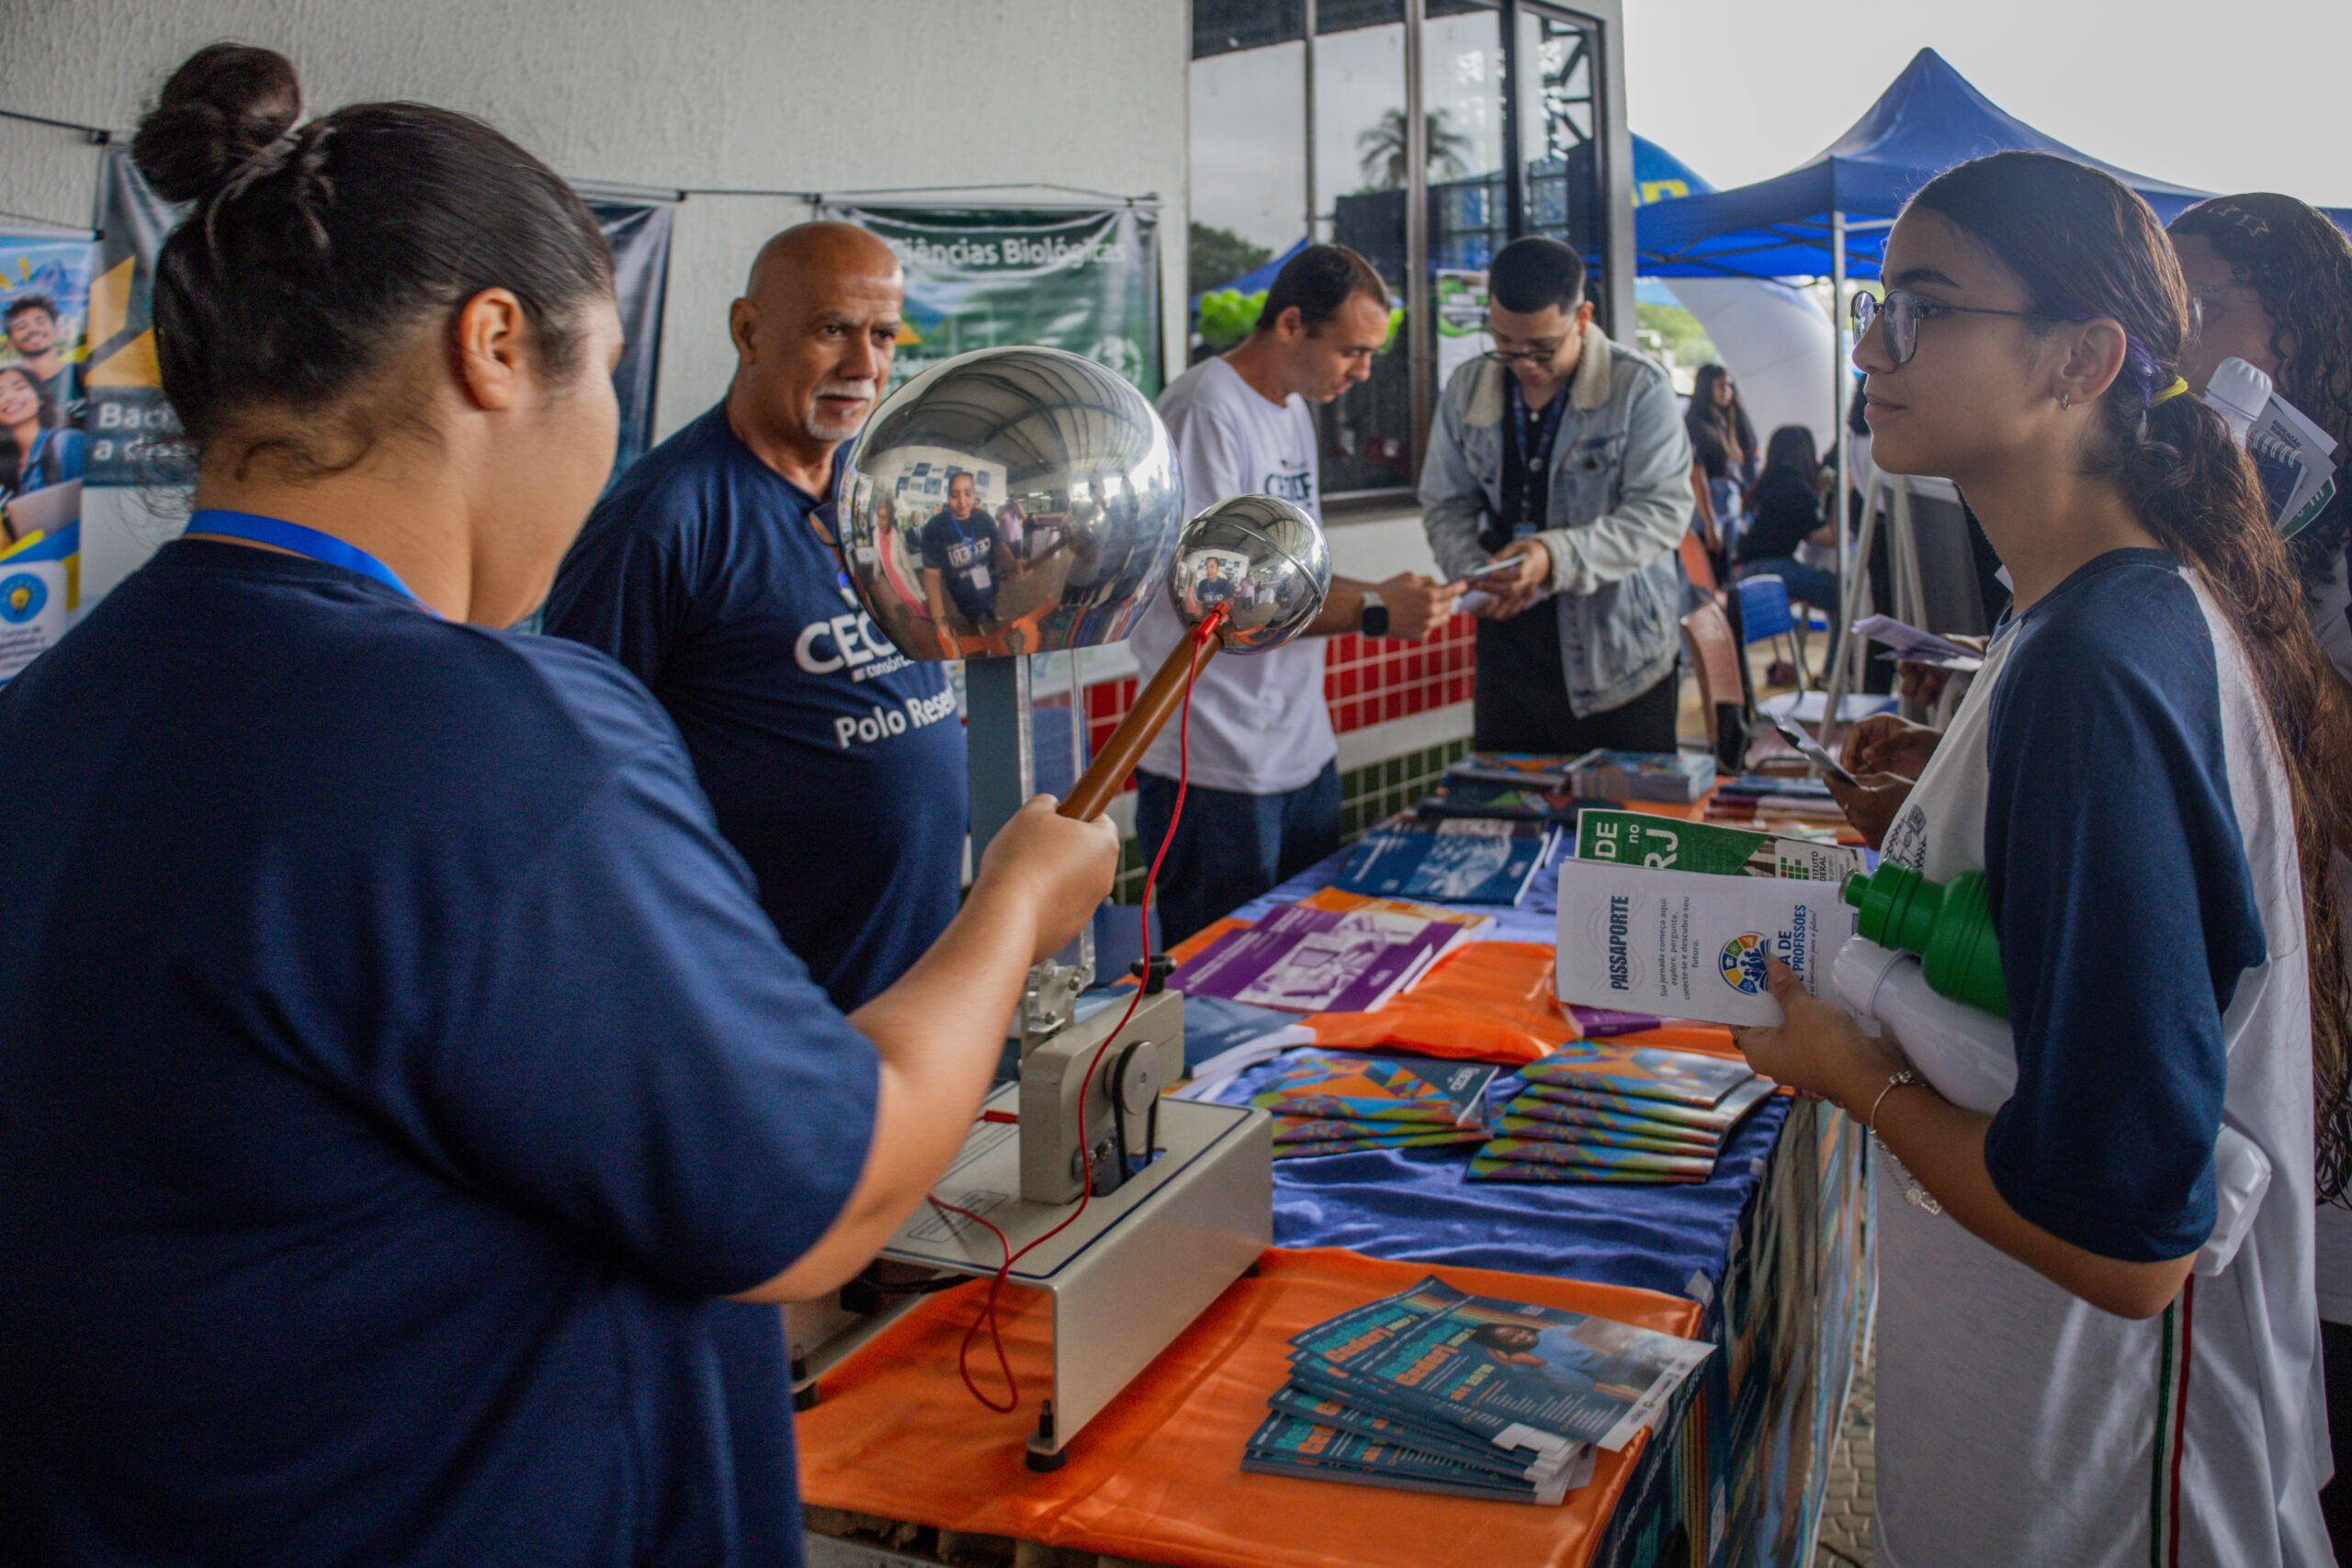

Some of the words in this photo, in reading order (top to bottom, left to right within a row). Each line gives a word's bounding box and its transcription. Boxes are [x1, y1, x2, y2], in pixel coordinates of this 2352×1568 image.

[1002, 236, 1127, 269] Biológicas
[94, 439, 114, 459] a
[795, 610, 898, 674] CEC
[865, 655, 917, 680] consór
[834, 705, 907, 750] Polo
[1595, 821, 1618, 858] DE
[1629, 824, 1640, 844] no
[1645, 829, 1679, 869] RJ
[1659, 897, 1668, 918] aqui:
[1610, 895, 1630, 991] PASSAPORTE
[1659, 919, 1668, 953] começa
[1670, 912, 1679, 953] pergunte,
[1680, 913, 1689, 953] descubra
[1778, 930, 1792, 950] DE
[1792, 904, 1806, 971] PROFISSÕES
[1658, 953, 1668, 984] jornada
[1669, 954, 1679, 986] explore,
[1691, 939, 1700, 968] futuro.
[1779, 954, 1792, 966] A
[1681, 961, 1690, 1000] conecte-se
